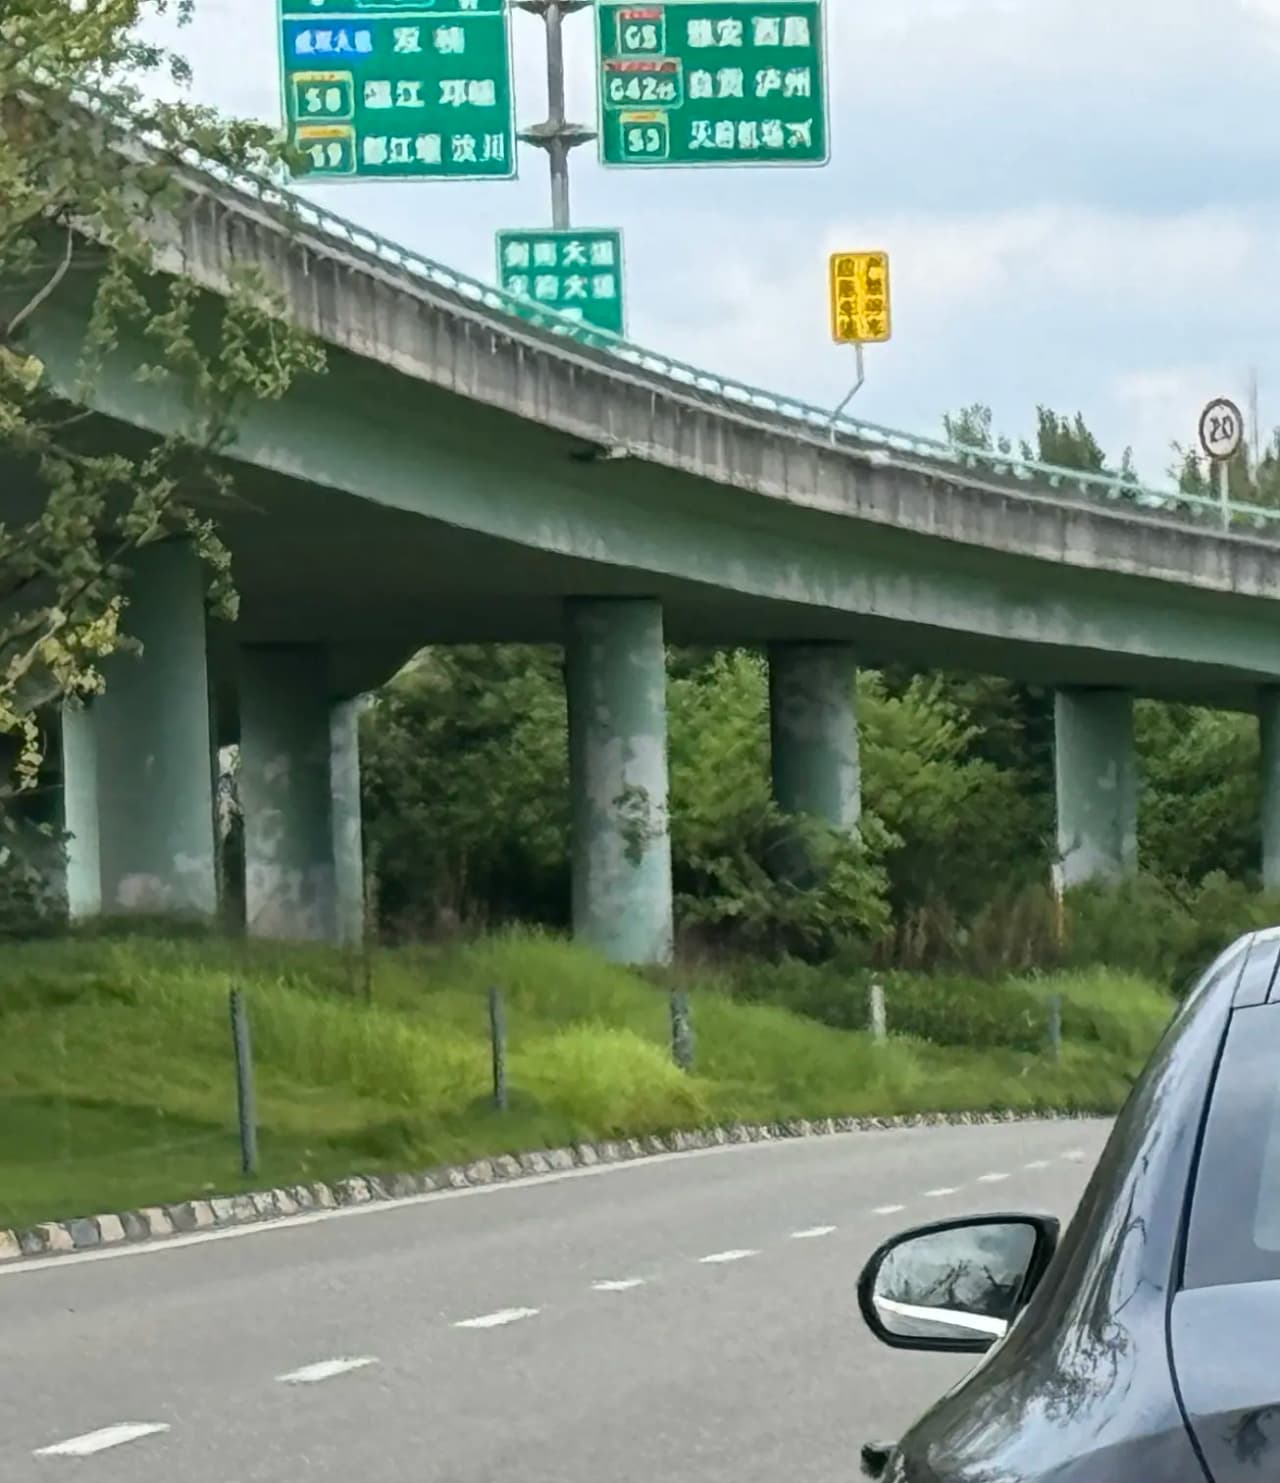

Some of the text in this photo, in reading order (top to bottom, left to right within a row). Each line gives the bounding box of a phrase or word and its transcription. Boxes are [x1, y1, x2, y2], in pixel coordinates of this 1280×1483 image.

[625, 24, 657, 49] G5
[689, 66, 811, 99] 自贡 泸州
[451, 133, 504, 163] 汶川
[1210, 415, 1234, 442] 20
